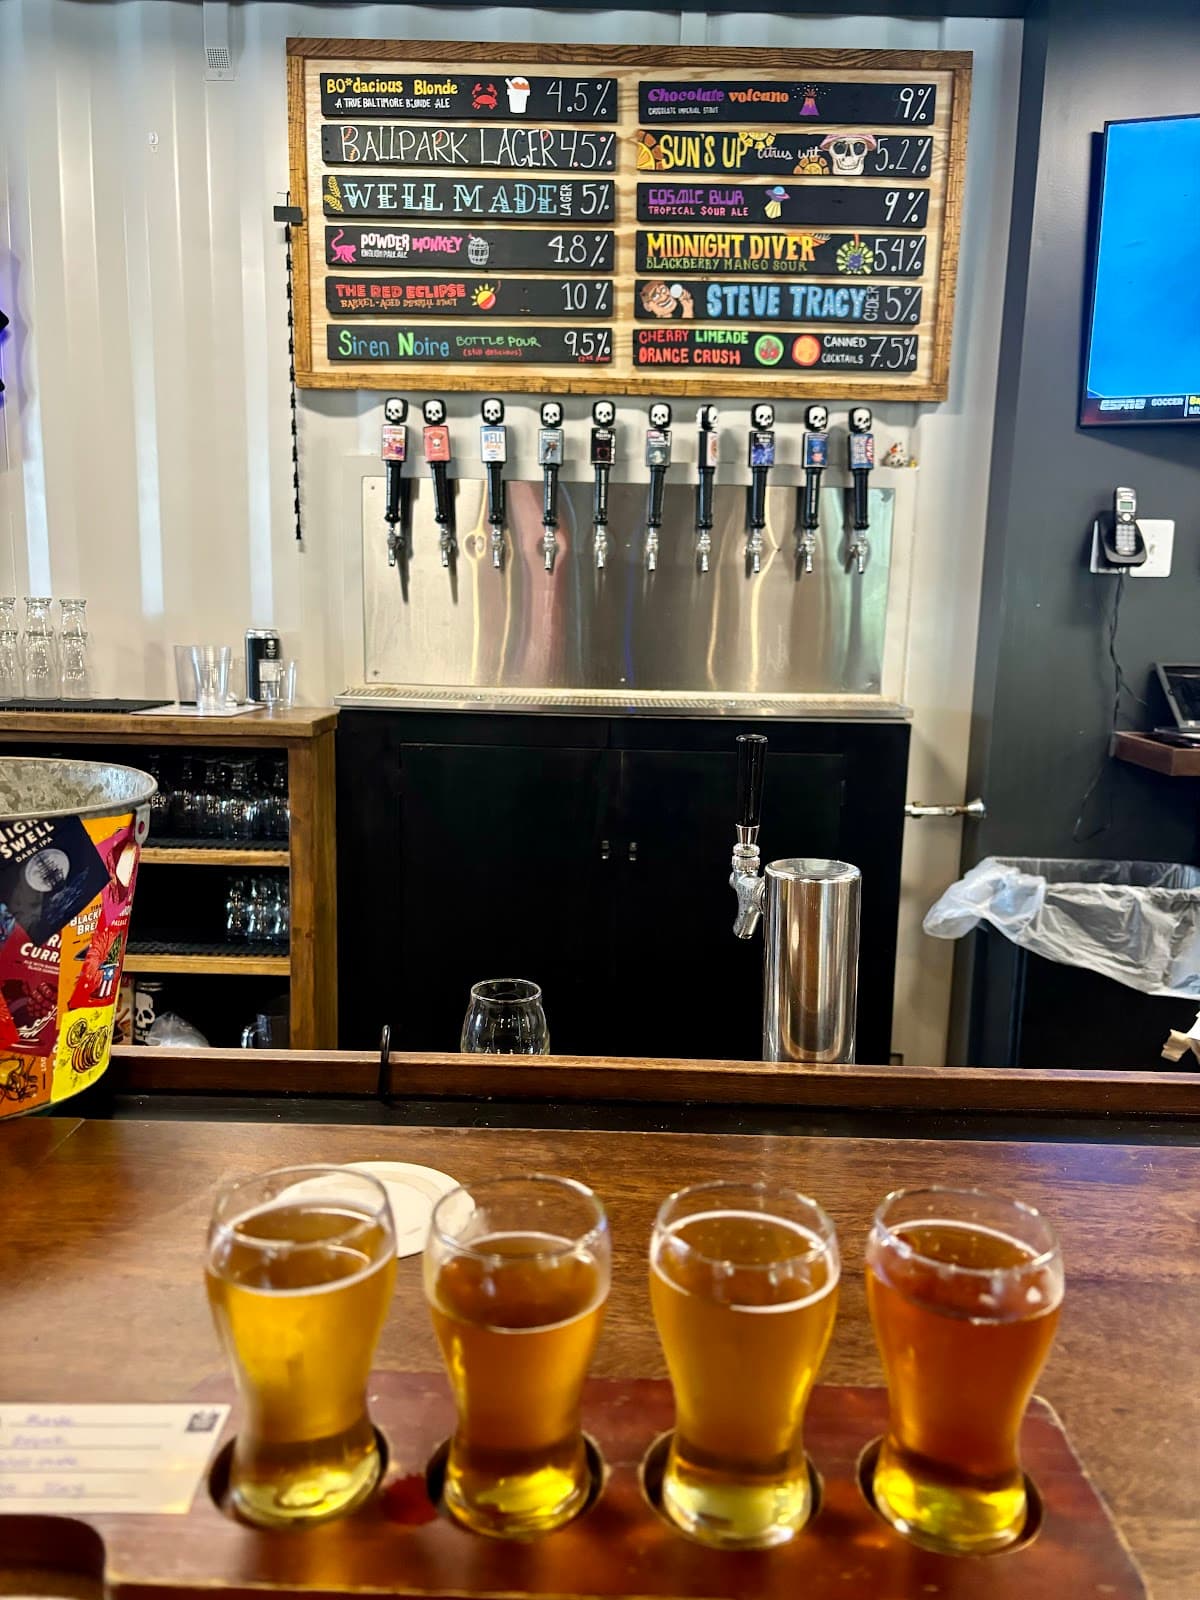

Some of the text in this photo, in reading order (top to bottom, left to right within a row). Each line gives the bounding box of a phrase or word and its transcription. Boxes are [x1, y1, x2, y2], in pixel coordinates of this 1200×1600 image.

[414, 79, 459, 95] Blonde
[546, 80, 612, 117] 4.5%
[647, 88, 789, 103] Chocolate volcano
[335, 98, 450, 109] A TRUE BALTIMORE BLONDE ALE
[647, 107, 677, 116] CHOCOLATE
[703, 106, 719, 114] STOUT
[900, 87, 932, 122] 9%
[340, 126, 558, 168] BALLPARK LAGER
[659, 133, 748, 170] SUN'S UP
[757, 144, 824, 160] citrus wit
[875, 137, 932, 174] 5.2%
[343, 183, 558, 215] WELL MADE
[559, 183, 573, 217] LAGER
[580, 183, 610, 216] 5%
[648, 205, 749, 217] TROPICAL SOUR ALE
[649, 189, 745, 206] COSMIC BLUR
[360, 232, 463, 253] POWDER MONKEY
[547, 234, 609, 268] 4.8%
[646, 233, 817, 262] MIDNIGHT DIVER
[873, 236, 926, 273] 5.4%
[646, 257, 808, 272] BLACKBERRY MANGO SOUR
[335, 284, 466, 299] THE RED ECLIPSE
[706, 284, 868, 319] STEVE TRACY
[862, 286, 880, 321] CIDER
[884, 286, 922, 322] 5%
[338, 329, 450, 357] Siren Noire
[455, 336, 542, 348] BOTTLE POUR
[564, 331, 611, 358] 9.5%
[638, 330, 749, 345] CHERRY LIMEADE
[823, 336, 867, 348] CANNED
[638, 347, 741, 365] ORANGE CRUSH
[821, 354, 864, 364] COCKTAILS
[868, 336, 916, 369] 7.5%
[0, 821, 55, 859] SWELL
[15, 836, 53, 863] DARK IPA
